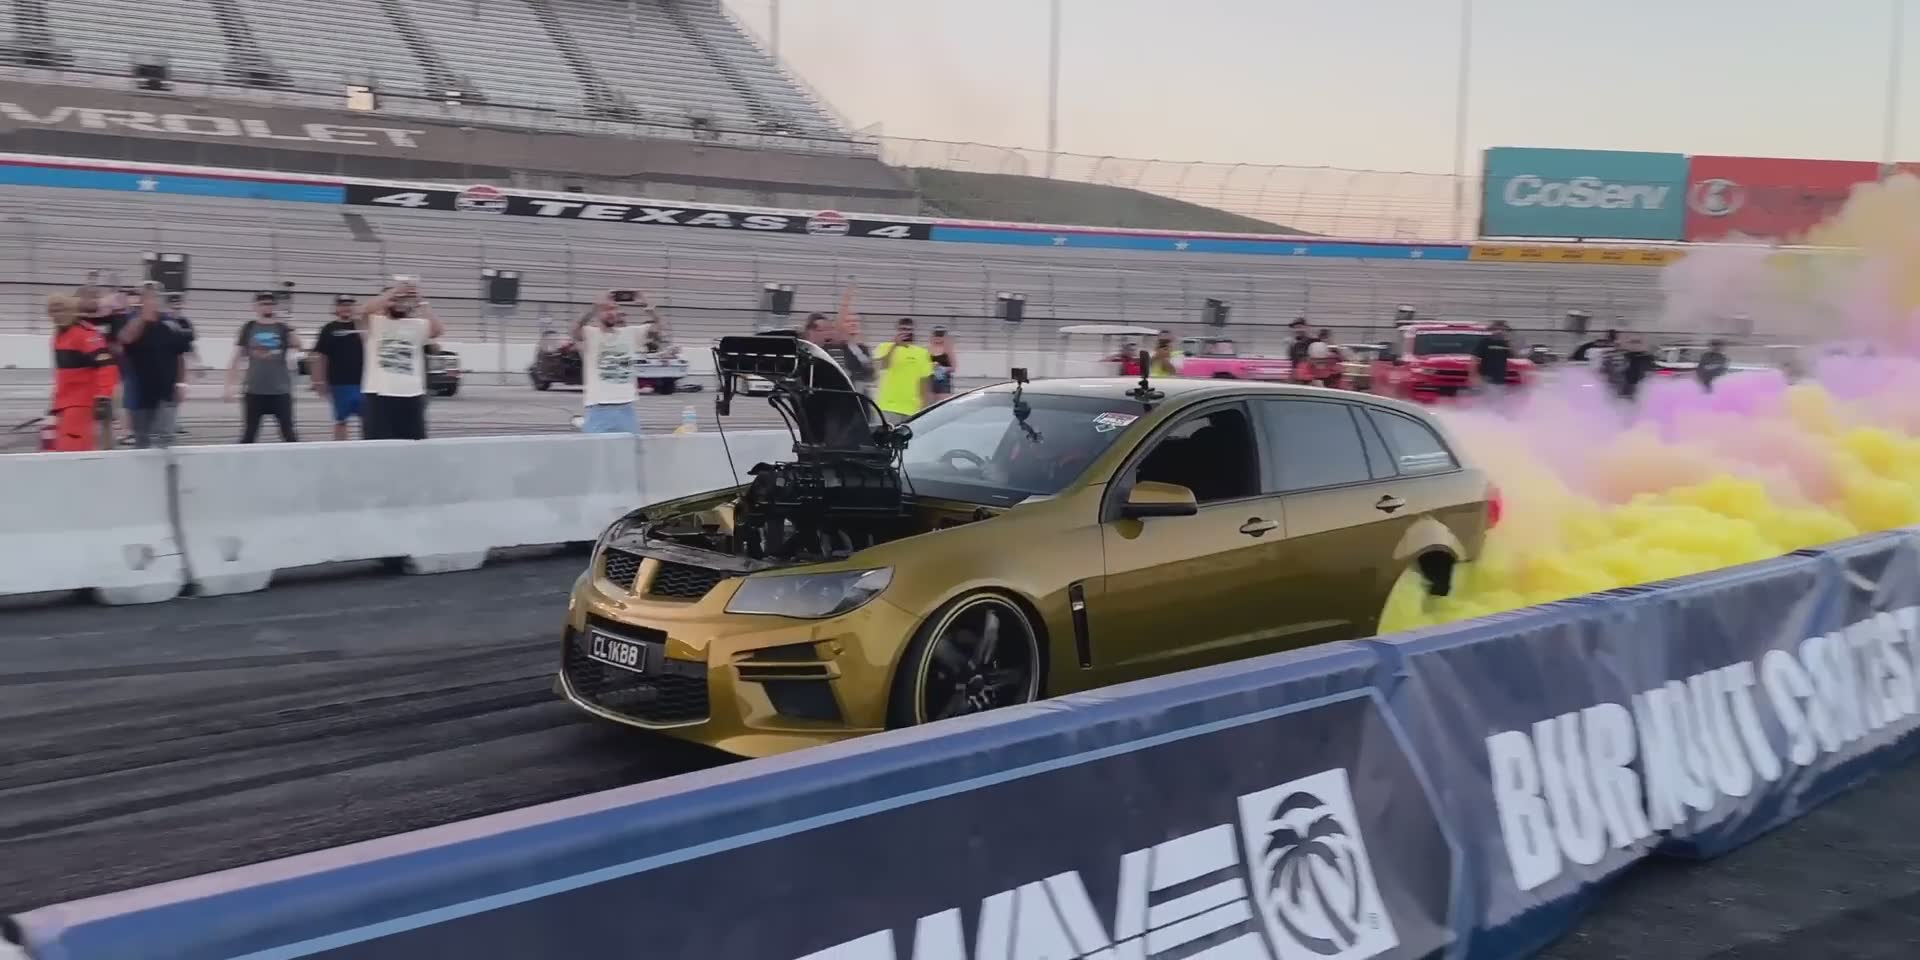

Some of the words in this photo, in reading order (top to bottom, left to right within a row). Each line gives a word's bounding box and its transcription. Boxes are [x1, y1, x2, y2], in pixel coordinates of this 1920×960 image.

[373, 191, 430, 208] 4
[529, 200, 792, 231] TEXAS
[867, 223, 912, 240] 4
[1504, 173, 1671, 210] CoServ
[1485, 661, 1782, 892] BURNOUT
